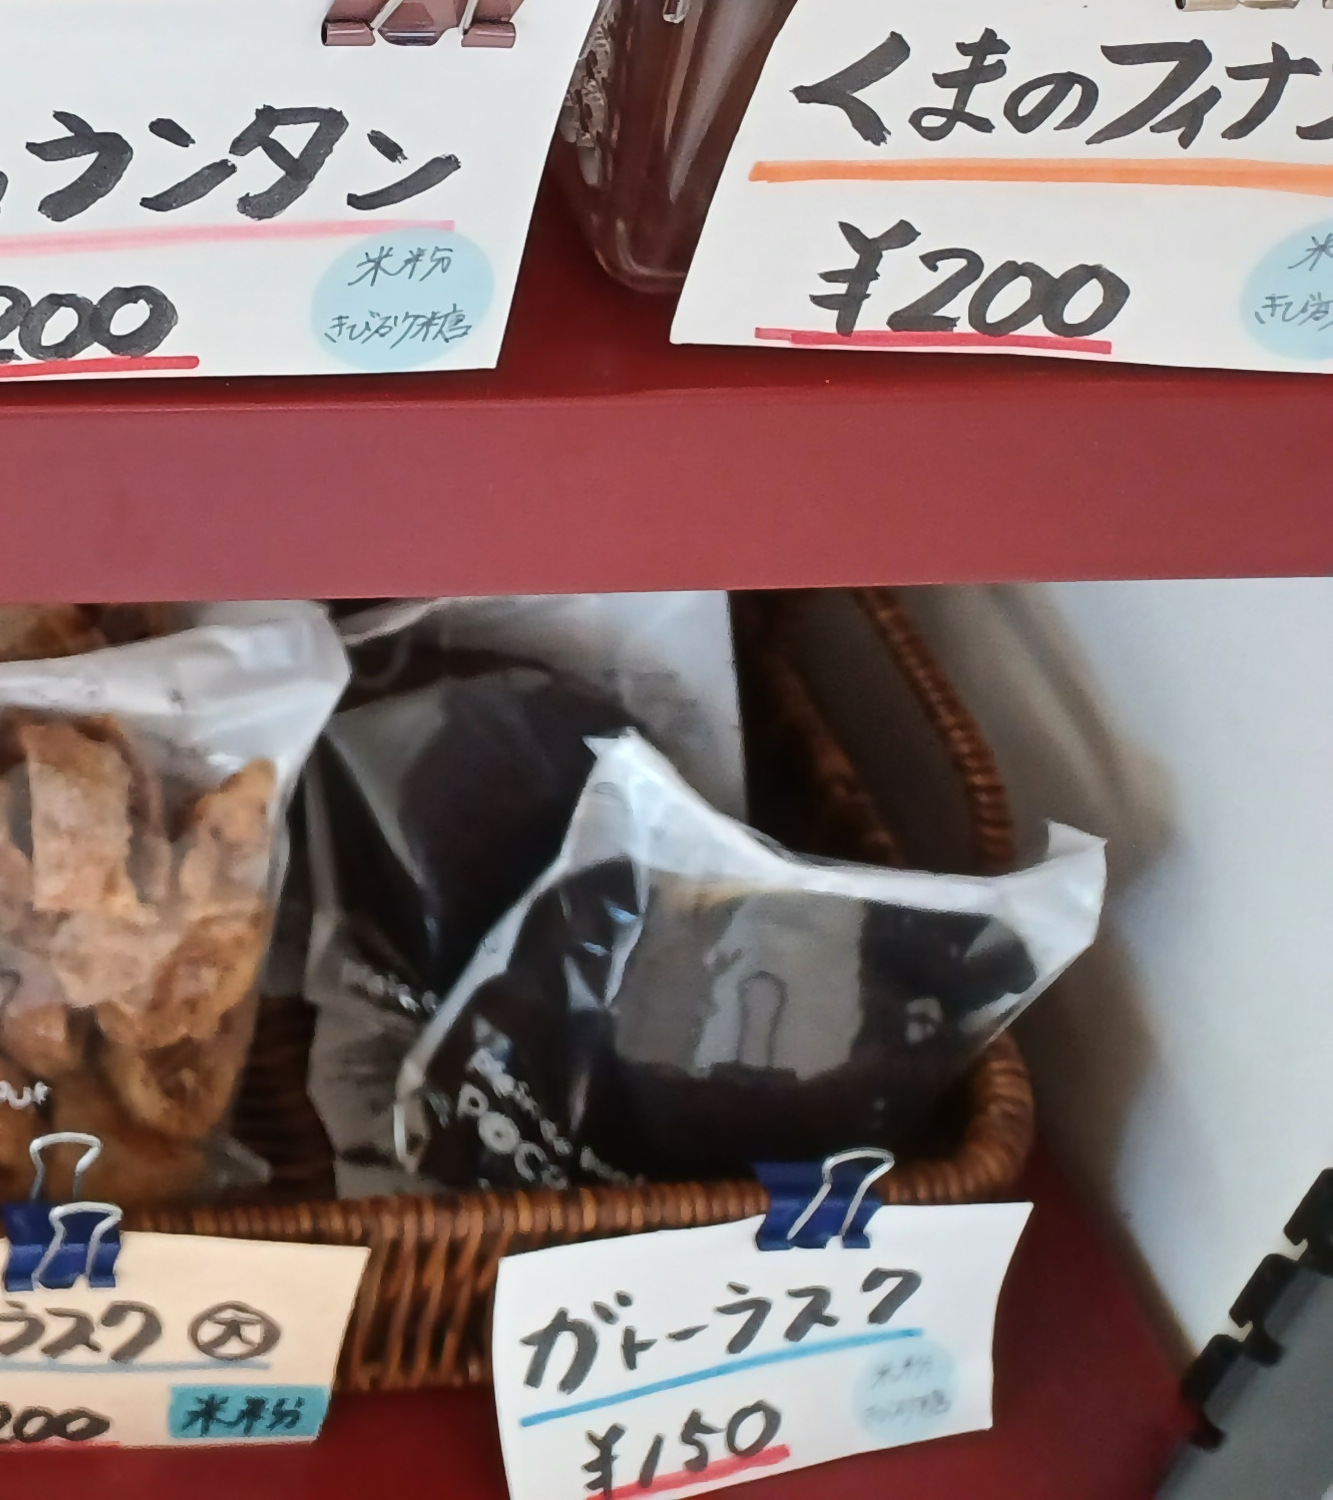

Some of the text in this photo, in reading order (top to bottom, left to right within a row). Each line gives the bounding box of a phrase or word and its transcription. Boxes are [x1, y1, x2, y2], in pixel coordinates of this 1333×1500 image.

[789, 26, 1333, 150] くまのフィナ
[809, 217, 1132, 338] ¥200
[518, 1266, 923, 1395] ガトーラスク
[581, 1399, 782, 1499] ¥150
